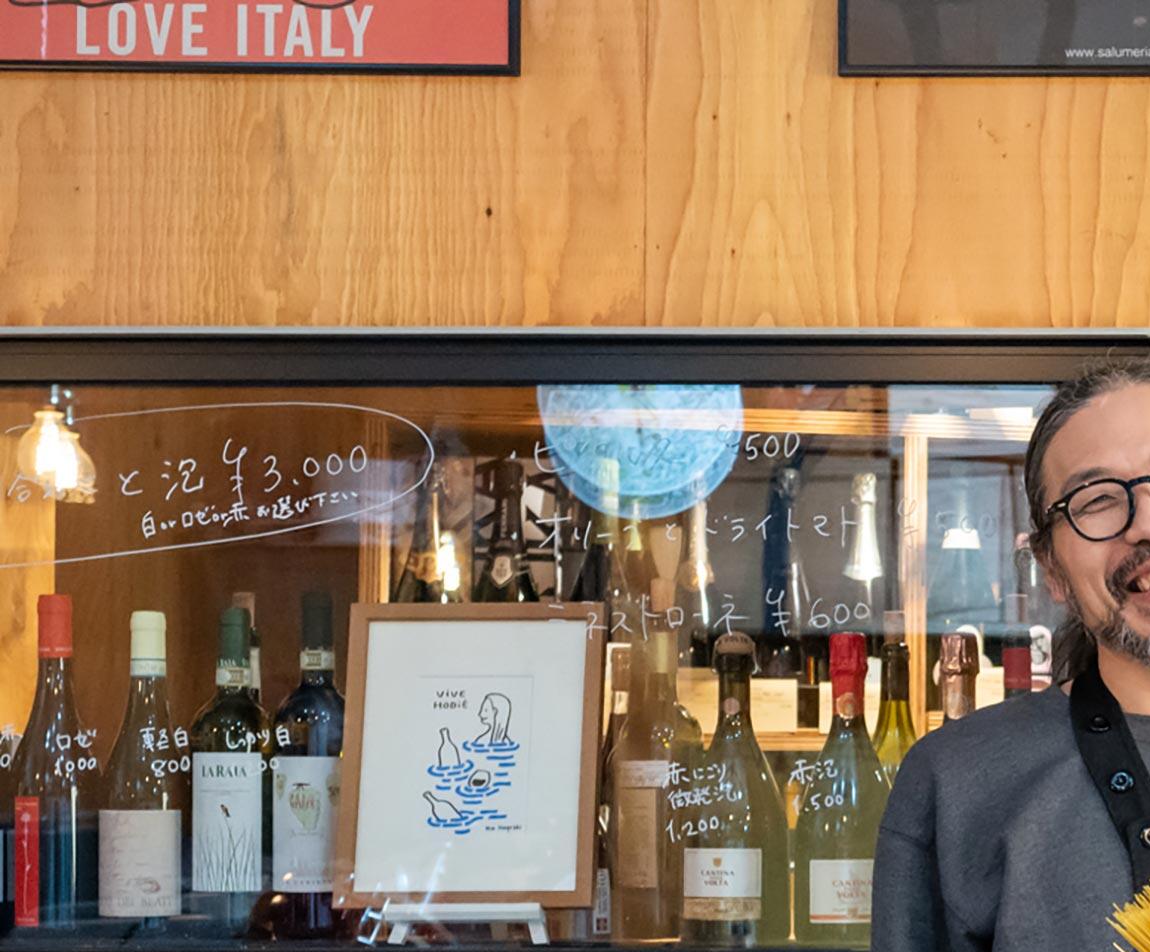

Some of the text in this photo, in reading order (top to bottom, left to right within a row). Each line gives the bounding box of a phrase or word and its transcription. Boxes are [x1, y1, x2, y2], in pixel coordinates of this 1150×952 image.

[76, 3, 374, 57] LOVE ITALY
[151, 755, 191, 777] 800
